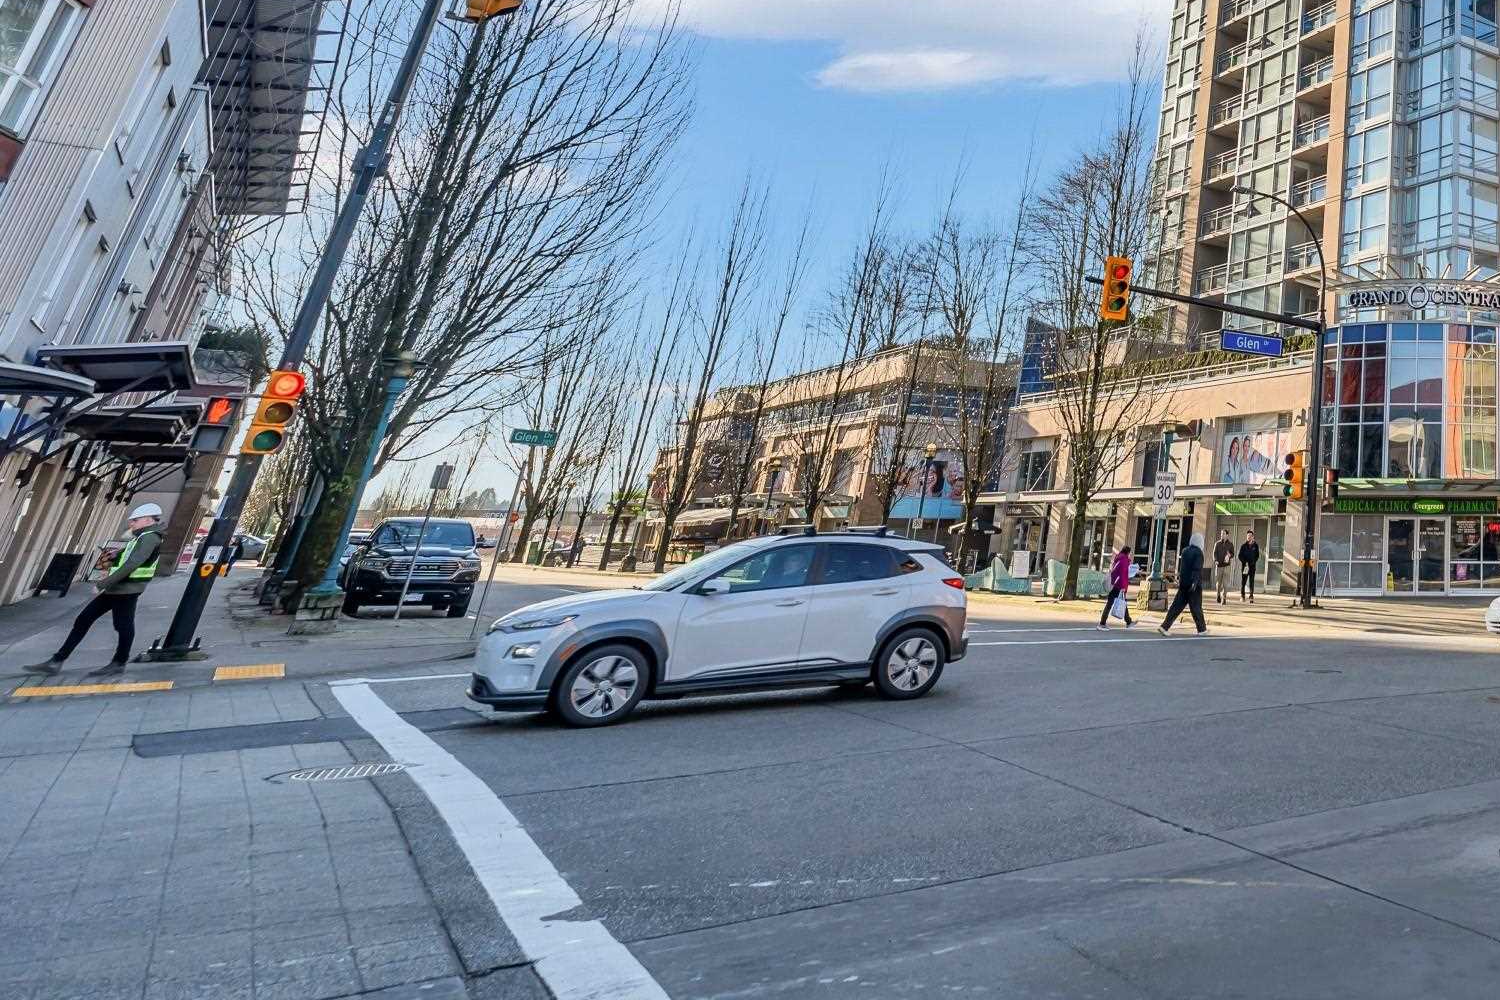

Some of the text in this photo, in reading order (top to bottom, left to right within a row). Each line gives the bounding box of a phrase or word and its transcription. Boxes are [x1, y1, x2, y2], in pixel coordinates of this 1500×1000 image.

[1350, 290, 1405, 307] GRAND
[1236, 336, 1260, 350] Glen
[514, 431, 538, 442] Glen
[1157, 485, 1171, 500] 30
[1336, 500, 1496, 513] MEDICAL CLINIC Evergreen PHARMACY
